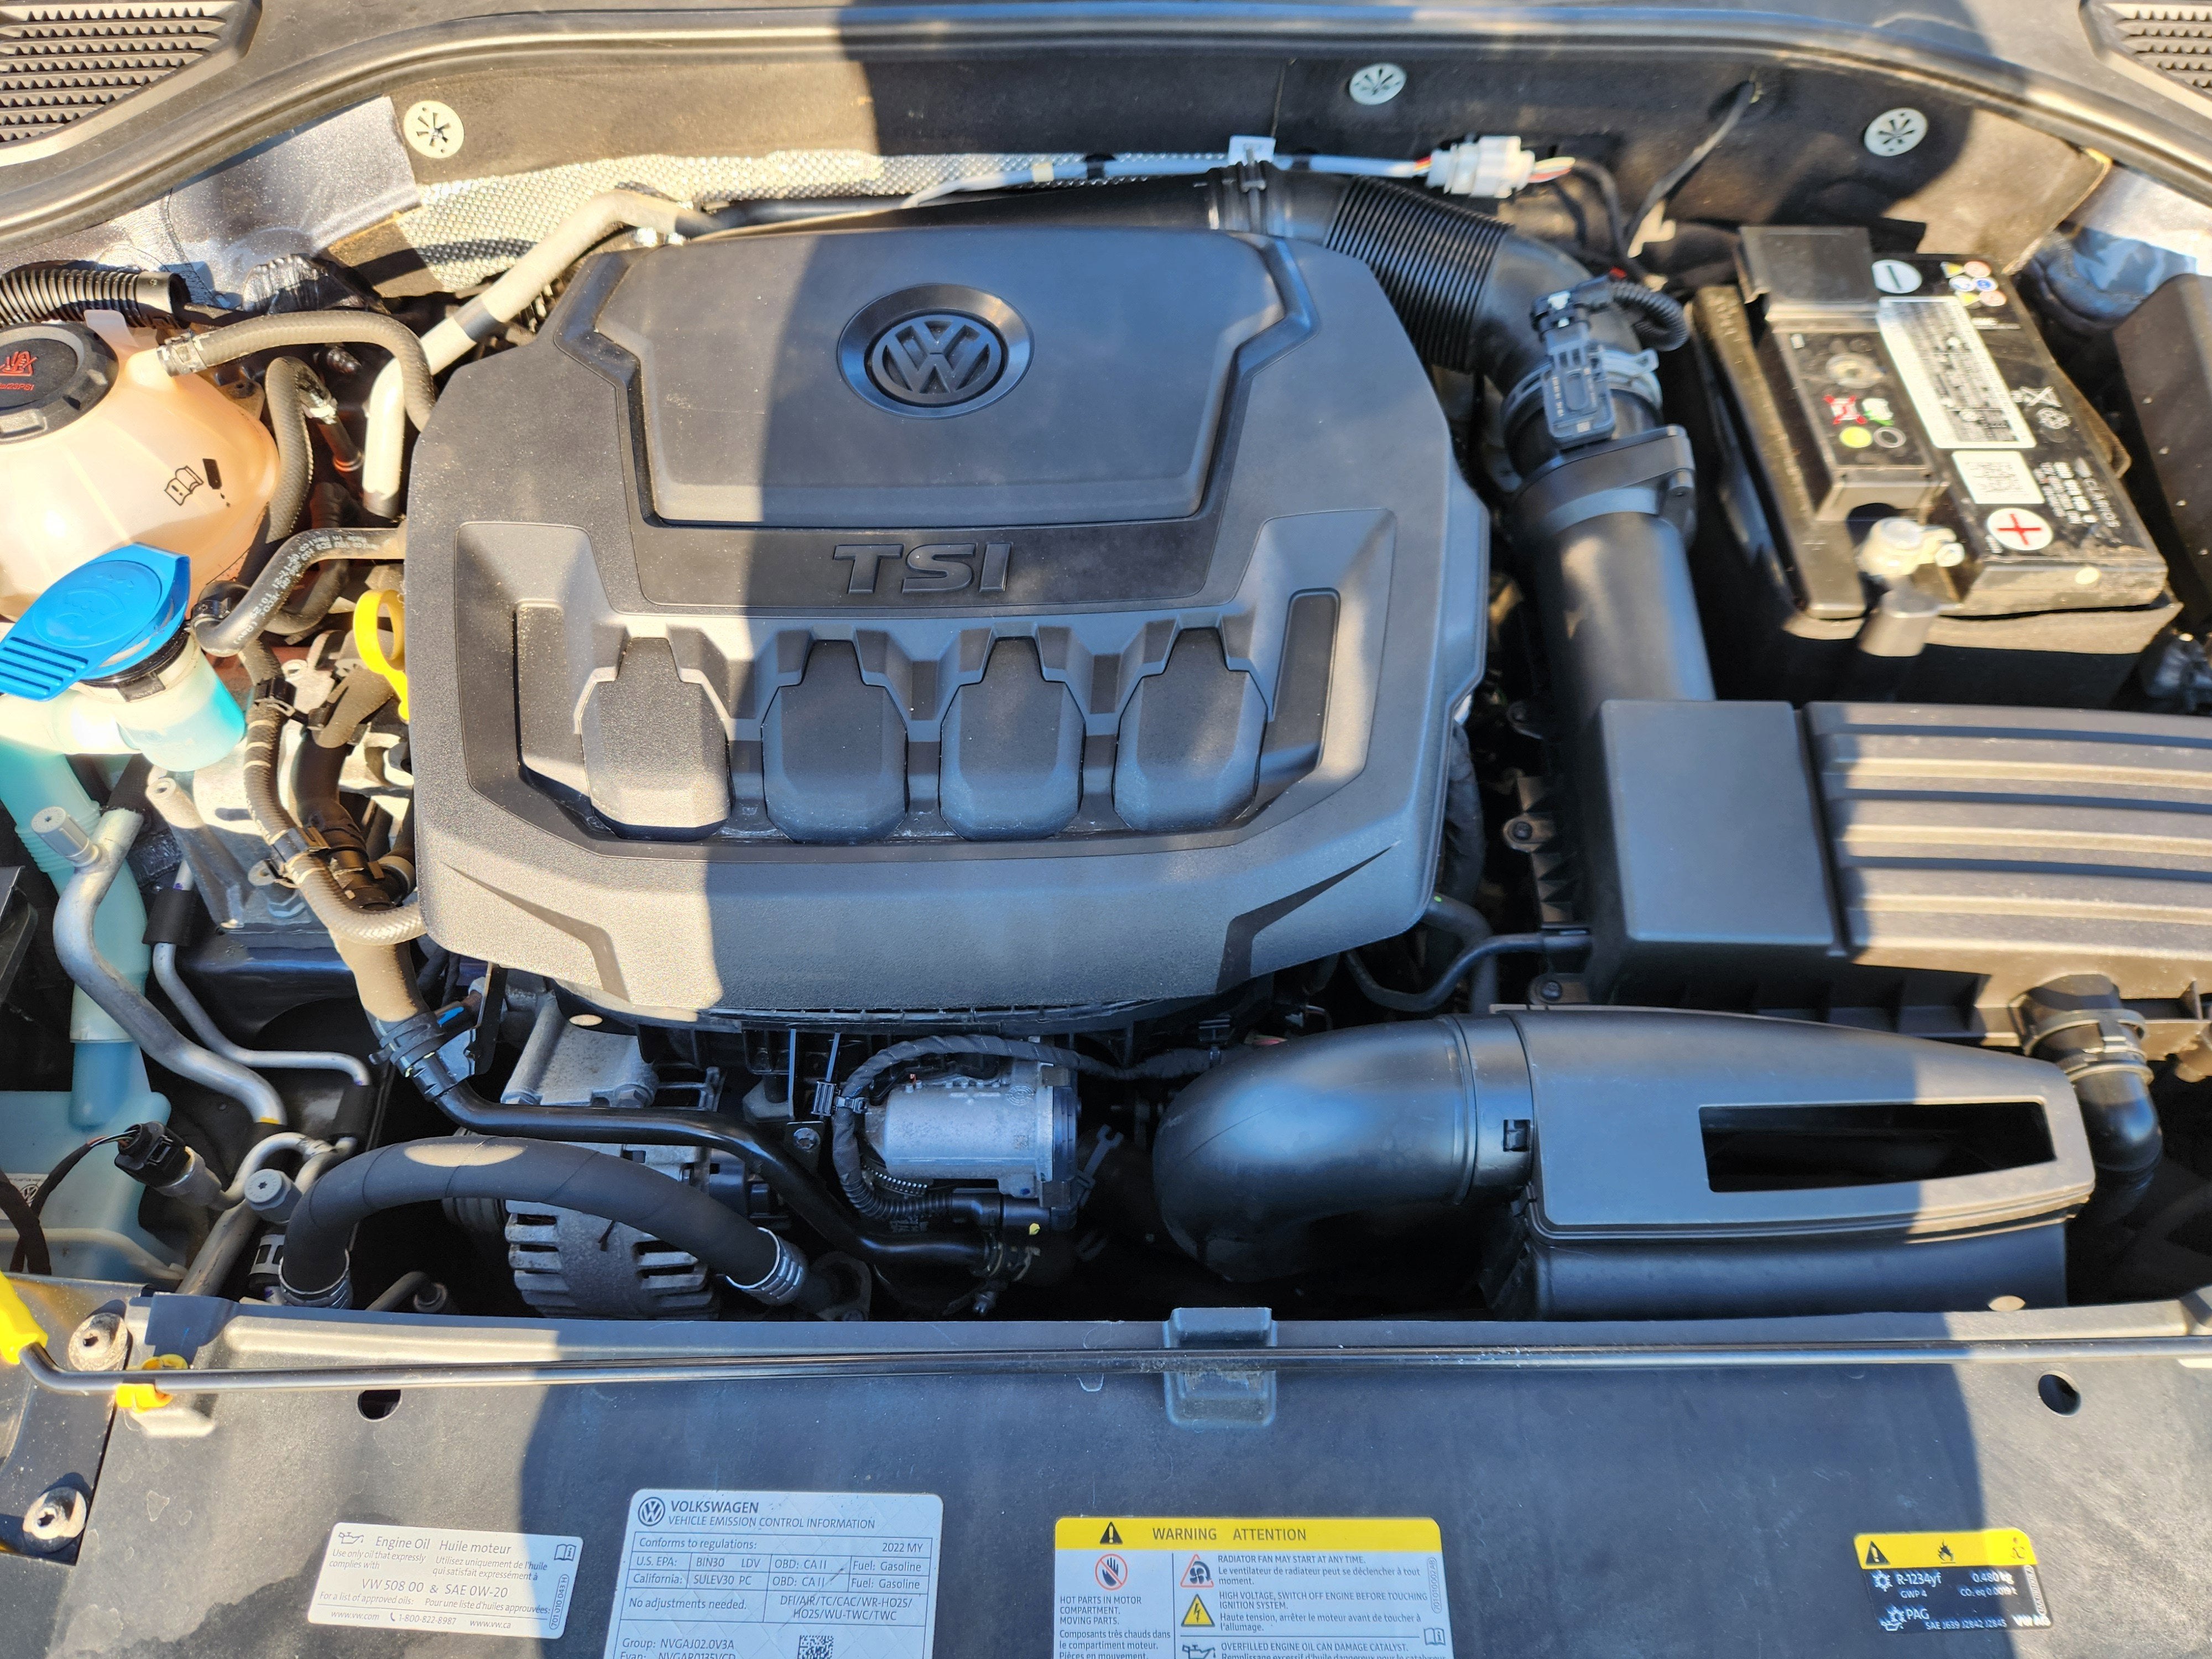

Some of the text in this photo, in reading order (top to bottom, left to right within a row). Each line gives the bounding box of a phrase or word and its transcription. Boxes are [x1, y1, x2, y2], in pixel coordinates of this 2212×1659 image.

[833, 542, 1014, 594] TSI
[671, 1500, 759, 1514] VOLKSWAGEN
[669, 1516, 875, 1529] VEHICLE EMISSION CONTROL INFORMATION
[1152, 1527, 1217, 1540] WARNING
[1233, 1528, 1306, 1541] ATTENTION
[375, 1536, 431, 1551] Engine Oil
[439, 1540, 512, 1554] Huile moteur
[639, 1537, 757, 1551] Conforms to regulations:
[882, 1542, 924, 1552] 2022 MY
[332, 1548, 426, 1564] Use only oil that expressly
[637, 1556, 677, 1567] U.S. EPA:
[1218, 1554, 1256, 1563] RADIATOR
[1292, 1555, 1316, 1563] START
[1317, 1555, 1327, 1563] AT
[1328, 1555, 1343, 1563] ANY
[329, 1559, 380, 1570] complies with
[436, 1556, 464, 1565] Utilisez
[465, 1558, 512, 1568] uniquement
[513, 1560, 523, 1569] de
[696, 1557, 761, 1568] BIN30 LDV
[775, 1559, 827, 1569] OBD: CA II
[853, 1560, 921, 1572] Fuel: Gasoline
[432, 1567, 538, 1581] qui satisfait expressément à
[1218, 1566, 1228, 1575] Le
[1229, 1566, 1271, 1575] ventilateur
[1273, 1566, 1284, 1575] de
[1285, 1567, 1320, 1575] radiateur
[1322, 1568, 1340, 1577] peut
[1353, 1567, 1395, 1575] déclencher
[1397, 1567, 1402, 1575] à
[633, 1573, 682, 1584] California:
[693, 1574, 752, 1585] SULEV30 PC
[773, 1576, 825, 1588] OBD: CA II
[851, 1578, 920, 1589] Fuel: Gasoline
[1895, 1572, 1942, 1588] R-1234yf
[362, 1578, 508, 1598] VW 508 00 & SAE 0W-20
[1901, 1589, 1920, 1598] GWP
[320, 1591, 332, 1600] For
[339, 1592, 351, 1601] list
[352, 1593, 362, 1601] of
[361, 1595, 398, 1605] approved
[398, 1596, 414, 1605] oils:
[780, 1595, 912, 1608] DFI/AIR/TC/CAC/WR-HO2S/
[1060, 1595, 1141, 1604] HOT PARTS IN MOTOR
[1219, 1591, 1428, 1601] HIGH VOLTAGE, SWITCH OFF ENGINE BEFORE TOUCHING
[425, 1598, 443, 1606] Pour
[459, 1600, 475, 1609] liste
[505, 1604, 551, 1614] approuvées:
[551, 1615, 559, 1627] 701
[557, 1585, 566, 1599] 043
[629, 1597, 747, 1611] No adjustments needed.
[1219, 1601, 1288, 1609] IGNITION SYSTEM.
[331, 1611, 380, 1620] www.vw.com
[793, 1609, 897, 1621] HO2S/WU-TWC/TWC
[1060, 1606, 1120, 1614] COMPARTMENT.
[1905, 1608, 1930, 1620] PAG
[399, 1614, 457, 1625] 1-800-822-8987
[1060, 1616, 1119, 1625] MOVING PARTS.
[1220, 1613, 1244, 1621] Haute
[1246, 1613, 1277, 1623] tension,
[1280, 1613, 1306, 1622] arrêter
[1308, 1613, 1316, 1622] le
[1372, 1613, 1382, 1622] de
[1384, 1614, 1413, 1623] toucher
[1416, 1613, 1421, 1623] à
[470, 1620, 512, 1629] www.vw.ca
[1926, 1621, 1942, 1630] SAE
[1060, 1629, 1171, 1640] Composants très chauds dans
[622, 1637, 656, 1651] Group:
[1060, 1640, 1159, 1651] le compartiment moteur.
[1221, 1642, 1408, 1651] OVERFILLED ENGINE OIL CAN DAMAGE CATALYST.
